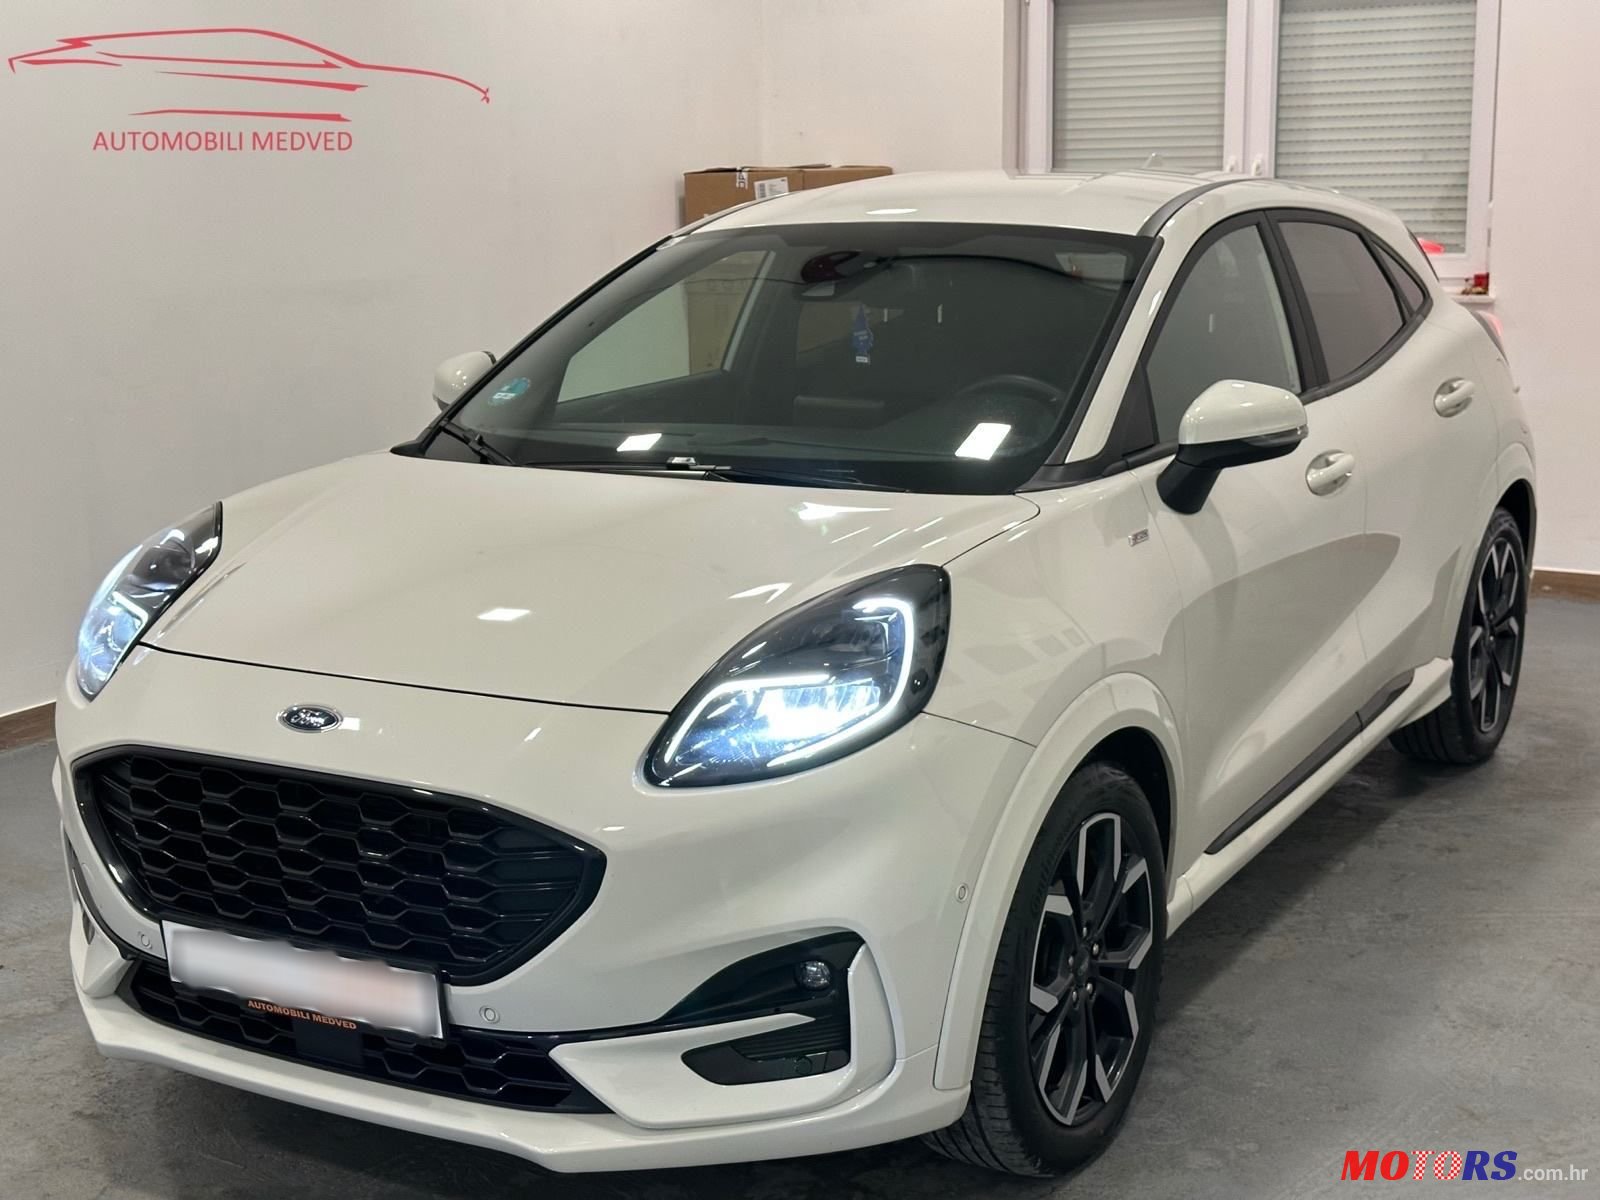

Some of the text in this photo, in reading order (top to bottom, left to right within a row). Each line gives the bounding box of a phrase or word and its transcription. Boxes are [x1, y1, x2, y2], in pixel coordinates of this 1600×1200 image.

[93, 131, 353, 152] AUTOMOBILI MEDVED
[247, 1000, 357, 1030] AUTOMOBILI MEDVED
